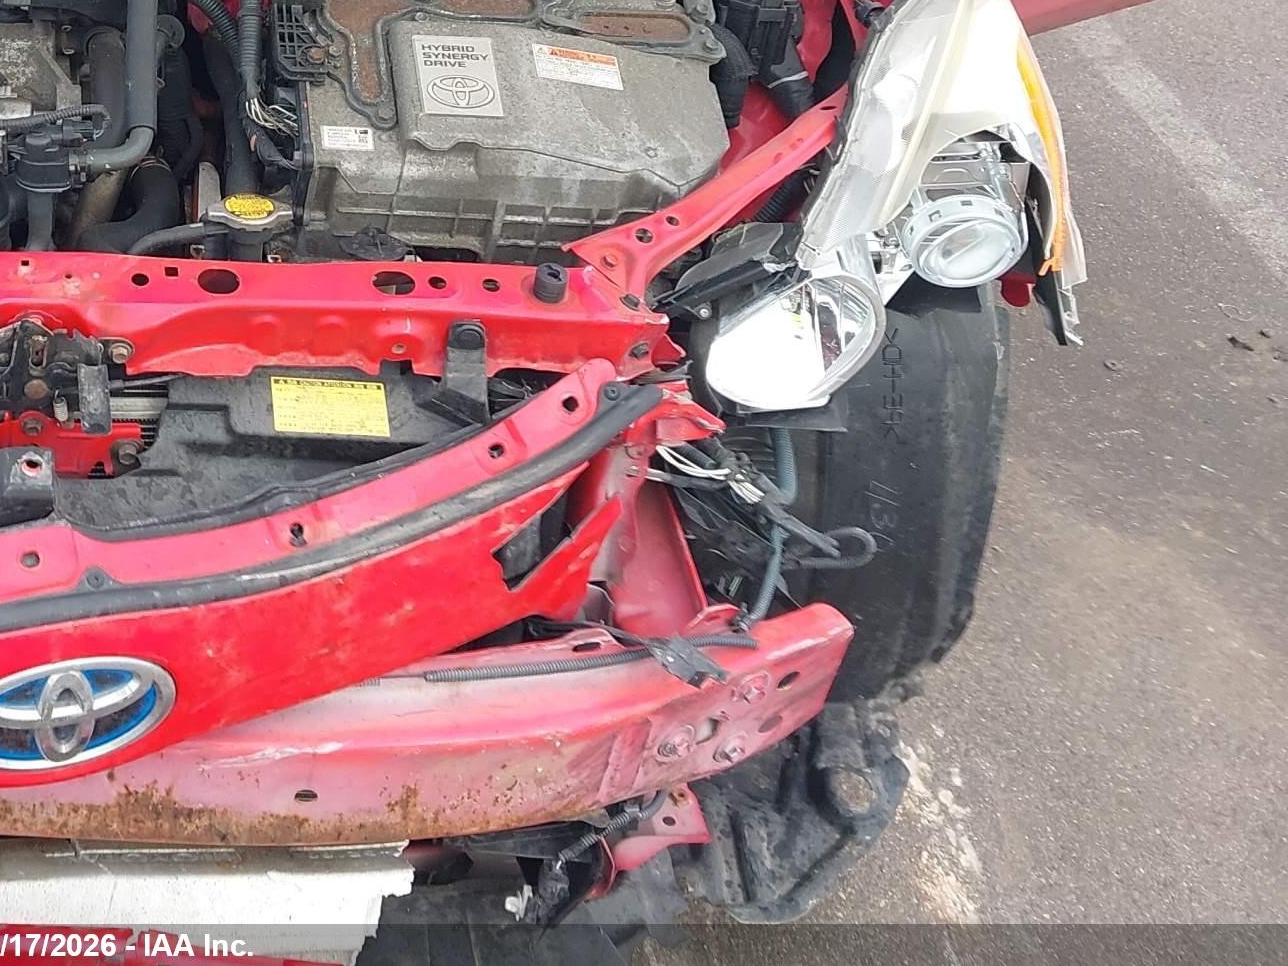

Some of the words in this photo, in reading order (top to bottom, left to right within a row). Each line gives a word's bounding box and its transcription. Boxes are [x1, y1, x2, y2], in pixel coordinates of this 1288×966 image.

[421, 44, 475, 53] HYBRID
[422, 52, 489, 61] SYNERGY
[423, 60, 467, 68] DRIVE
